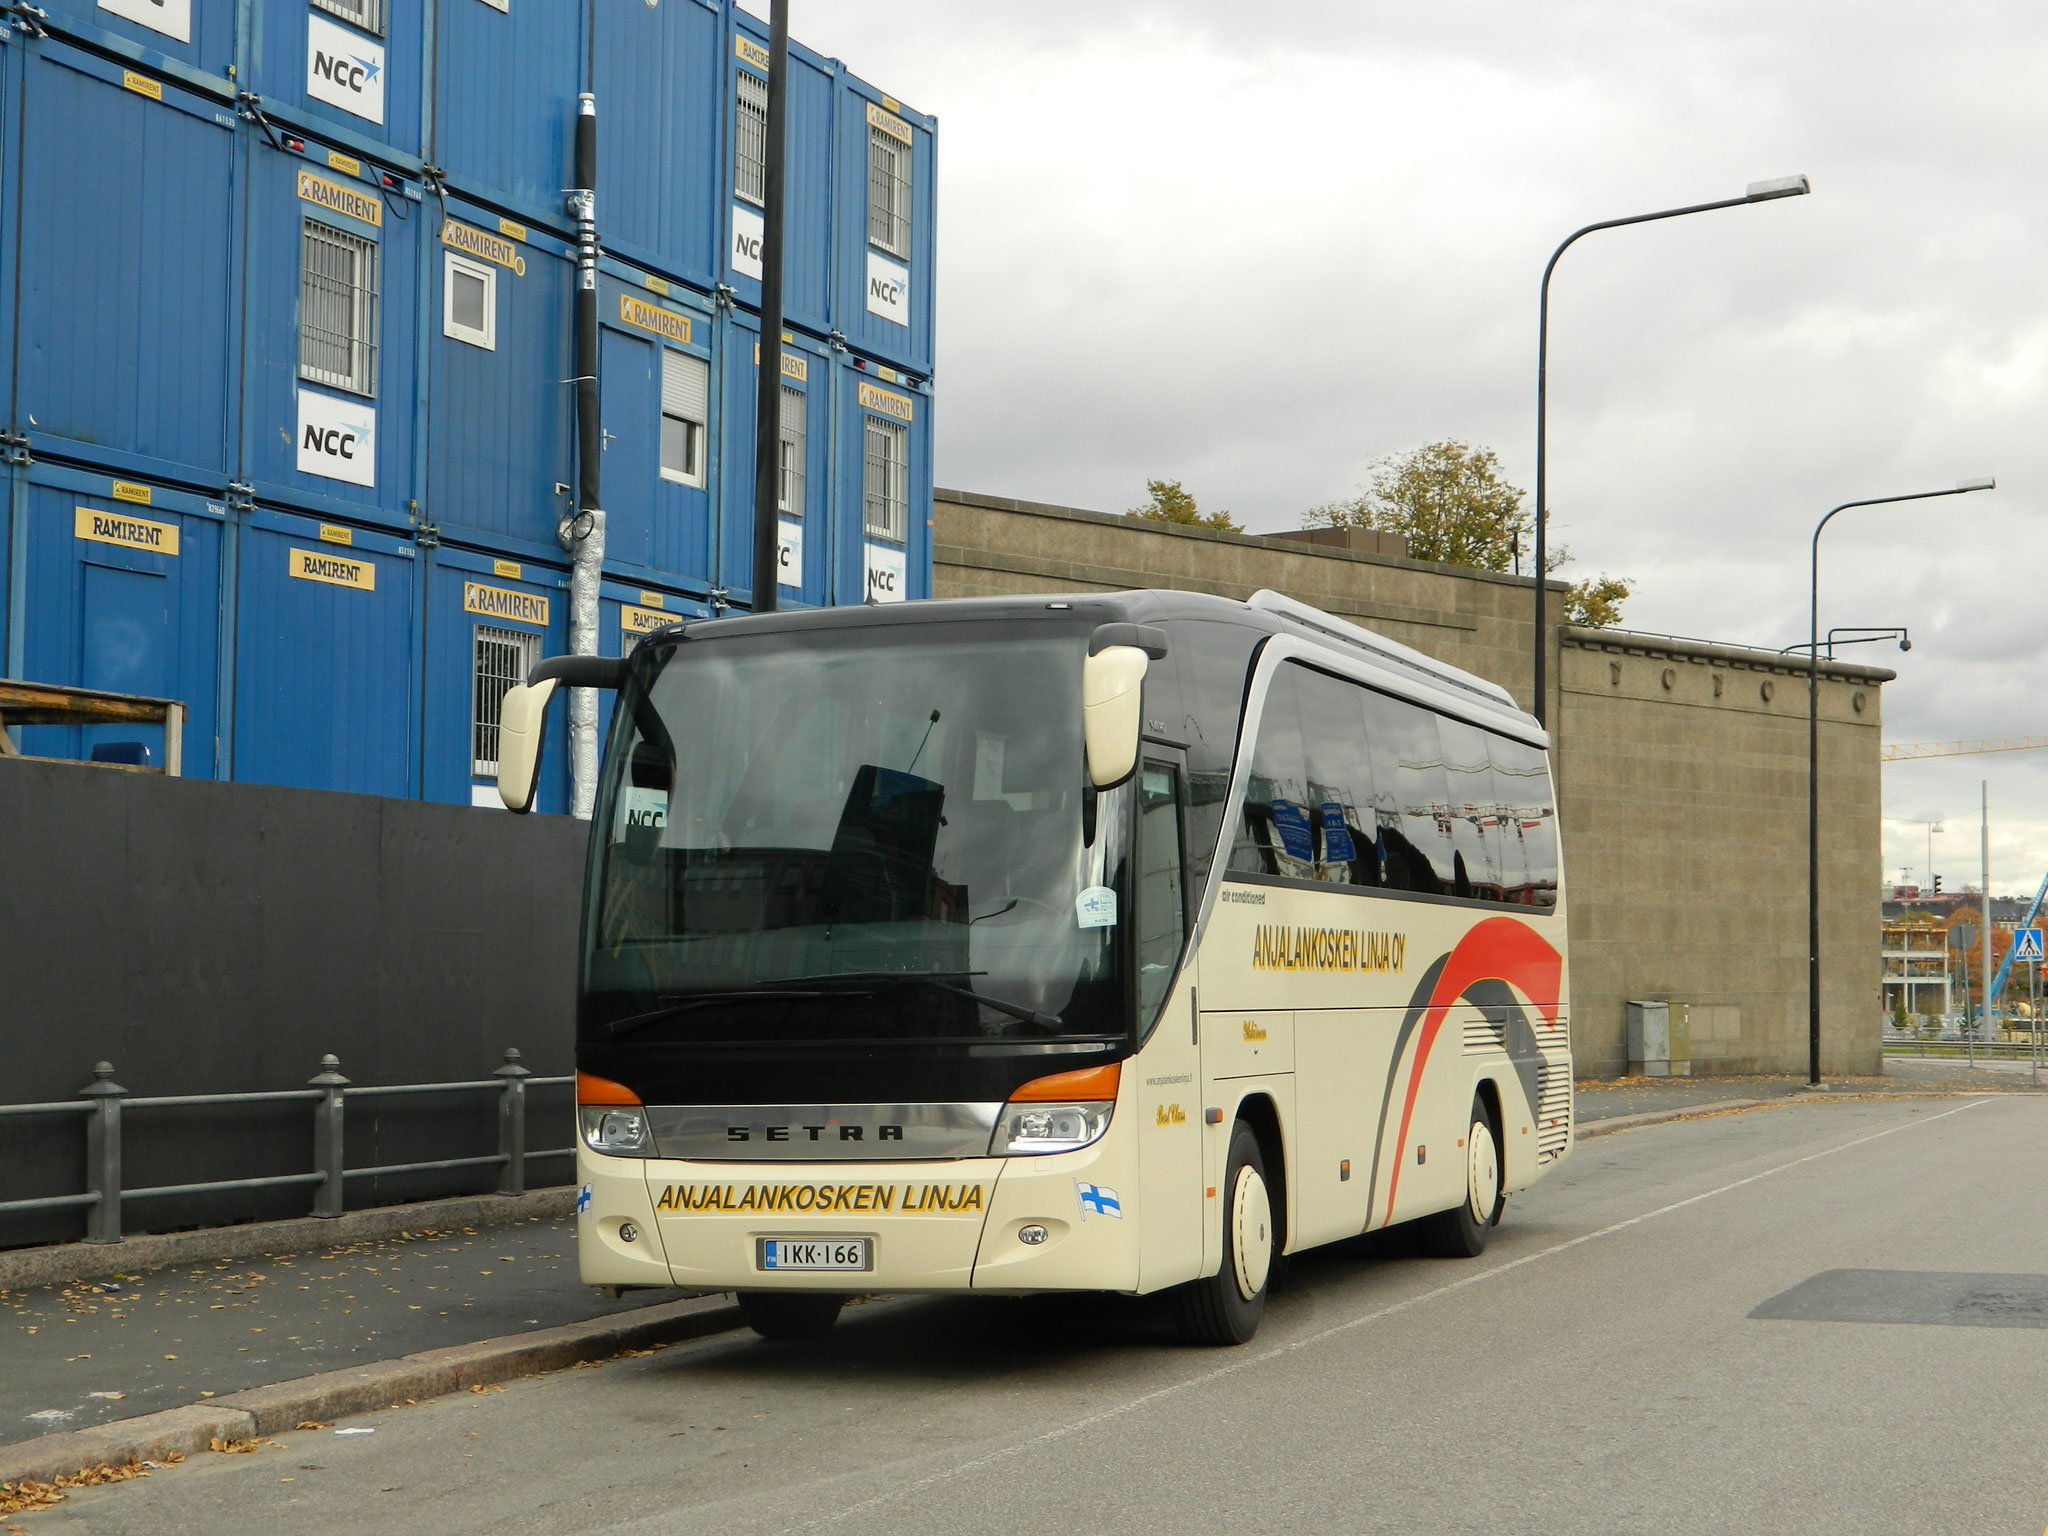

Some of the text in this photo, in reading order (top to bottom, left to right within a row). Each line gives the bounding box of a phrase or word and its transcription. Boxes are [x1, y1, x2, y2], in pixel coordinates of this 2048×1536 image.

[743, 42, 769, 67] RAMIRE
[132, 76, 160, 93] RAMIRENT
[313, 50, 364, 93] NCC
[876, 110, 908, 139] RAMIRENT
[312, 180, 377, 223] RAMIRENT
[455, 225, 512, 264] RAMIRENT
[870, 277, 897, 305] NCC
[634, 303, 689, 341] RAMIRENT
[782, 358, 804, 378] IRENT
[869, 390, 911, 419] RAMIRENT
[303, 424, 356, 460] NCC
[121, 485, 149, 498] RAMIRENT
[93, 516, 162, 546] RAMIRENT
[327, 529, 350, 540] RAMIRENT
[303, 556, 361, 582] RAMIRENT
[868, 568, 895, 592] NCC
[478, 588, 546, 622] RAMIRENT
[1222, 888, 1266, 905] air conditioned
[1253, 924, 1406, 973] ANJALANKOSKEN LINJA OY
[727, 1126, 904, 1142] SETRA
[657, 1184, 984, 1212] ANJALANKOSKEN LINJA
